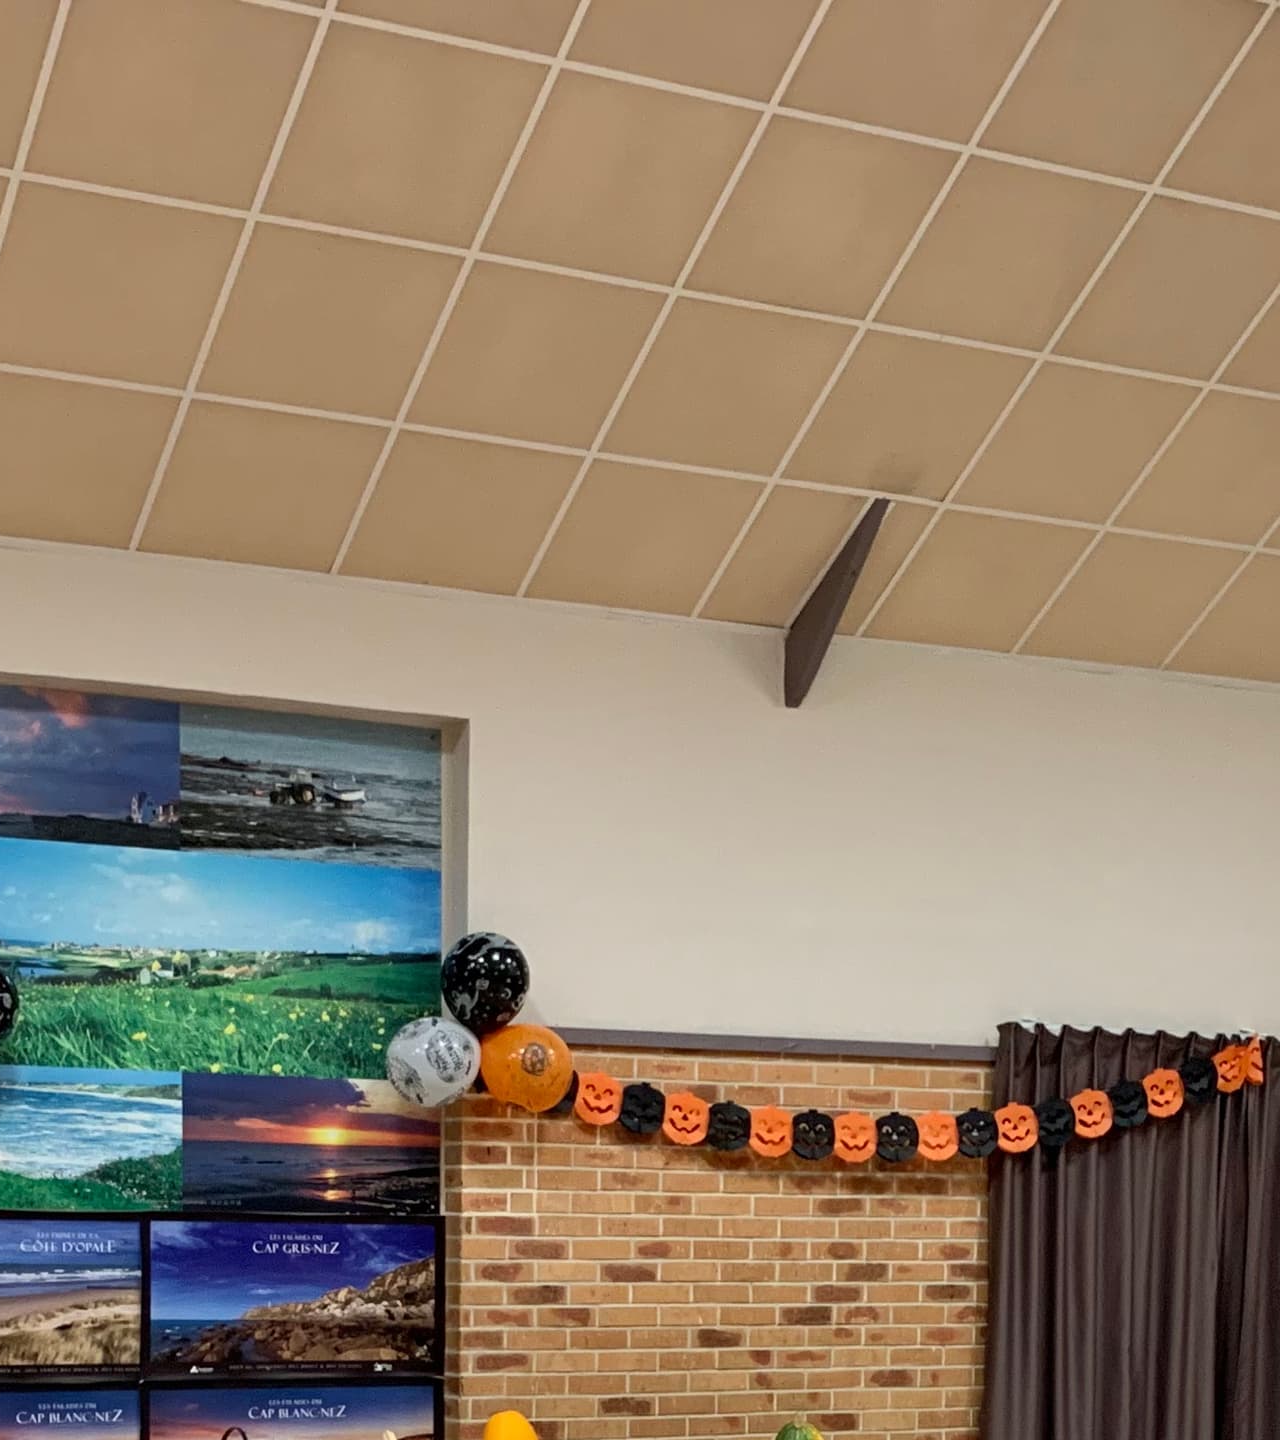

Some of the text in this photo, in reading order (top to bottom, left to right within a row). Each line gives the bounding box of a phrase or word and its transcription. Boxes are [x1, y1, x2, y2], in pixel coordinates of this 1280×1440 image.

[62, 1239, 118, 1254] D'OPALE
[252, 1240, 279, 1254] CAP
[16, 1411, 45, 1424] CAP
[248, 1406, 275, 1419] CAP
